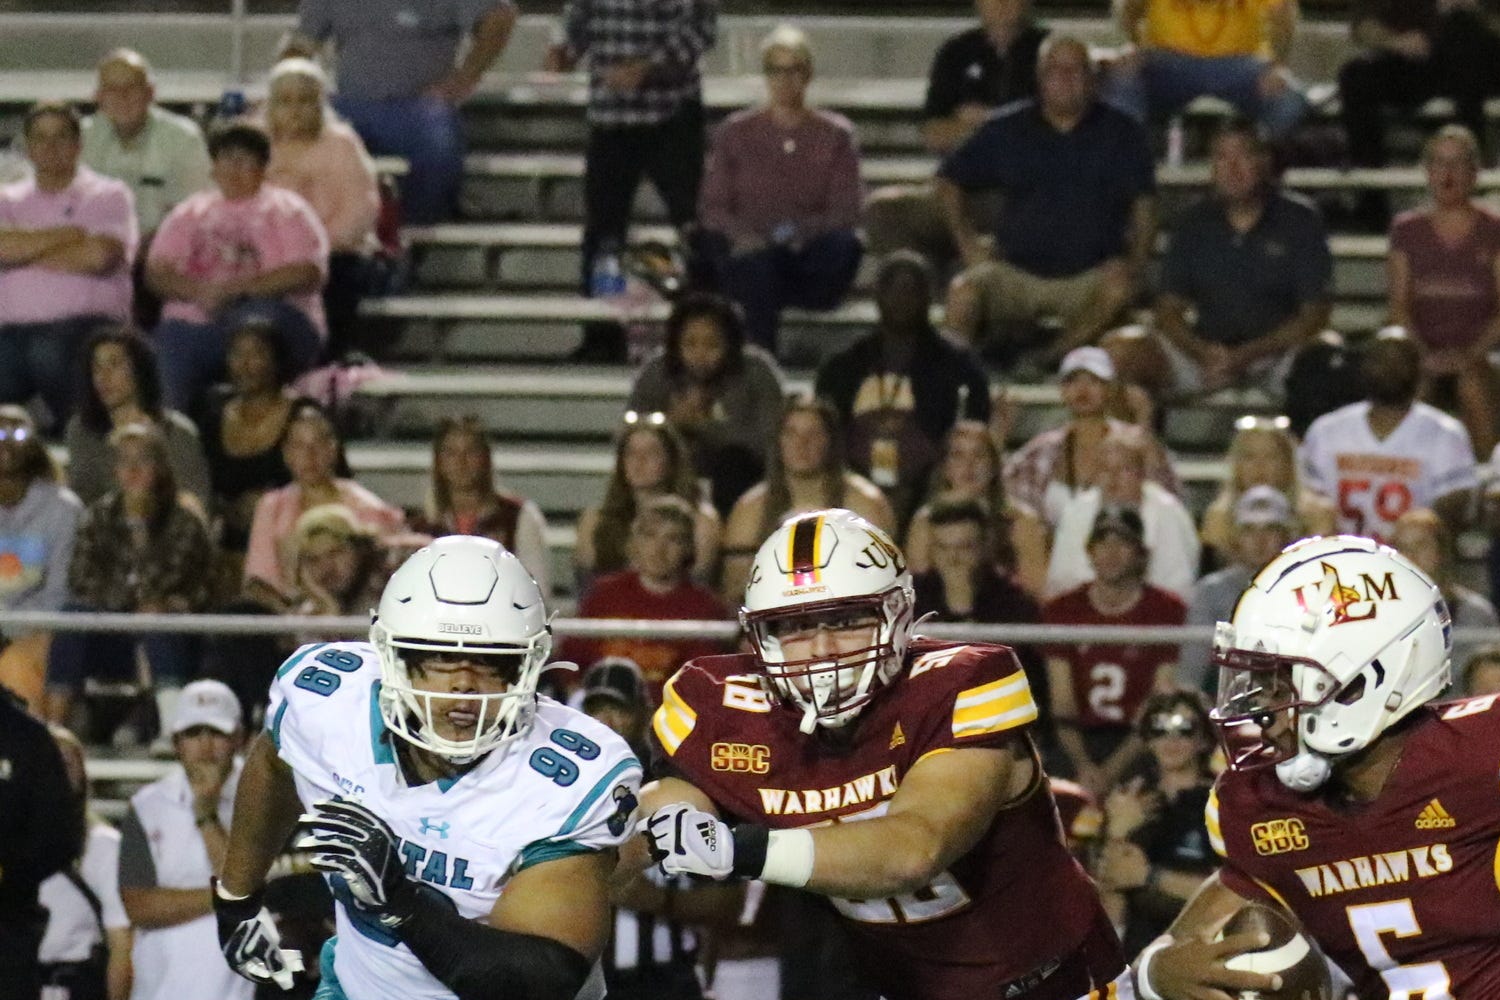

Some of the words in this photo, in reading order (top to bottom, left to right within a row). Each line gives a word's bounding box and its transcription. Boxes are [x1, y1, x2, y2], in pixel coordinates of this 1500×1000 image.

[1088, 662, 1126, 721] 2
[528, 727, 601, 787] 99
[710, 742, 770, 774] SBC
[1250, 818, 1310, 856] SBC
[1414, 817, 1456, 829] adidas
[1294, 844, 1454, 898] WARHAWKS
